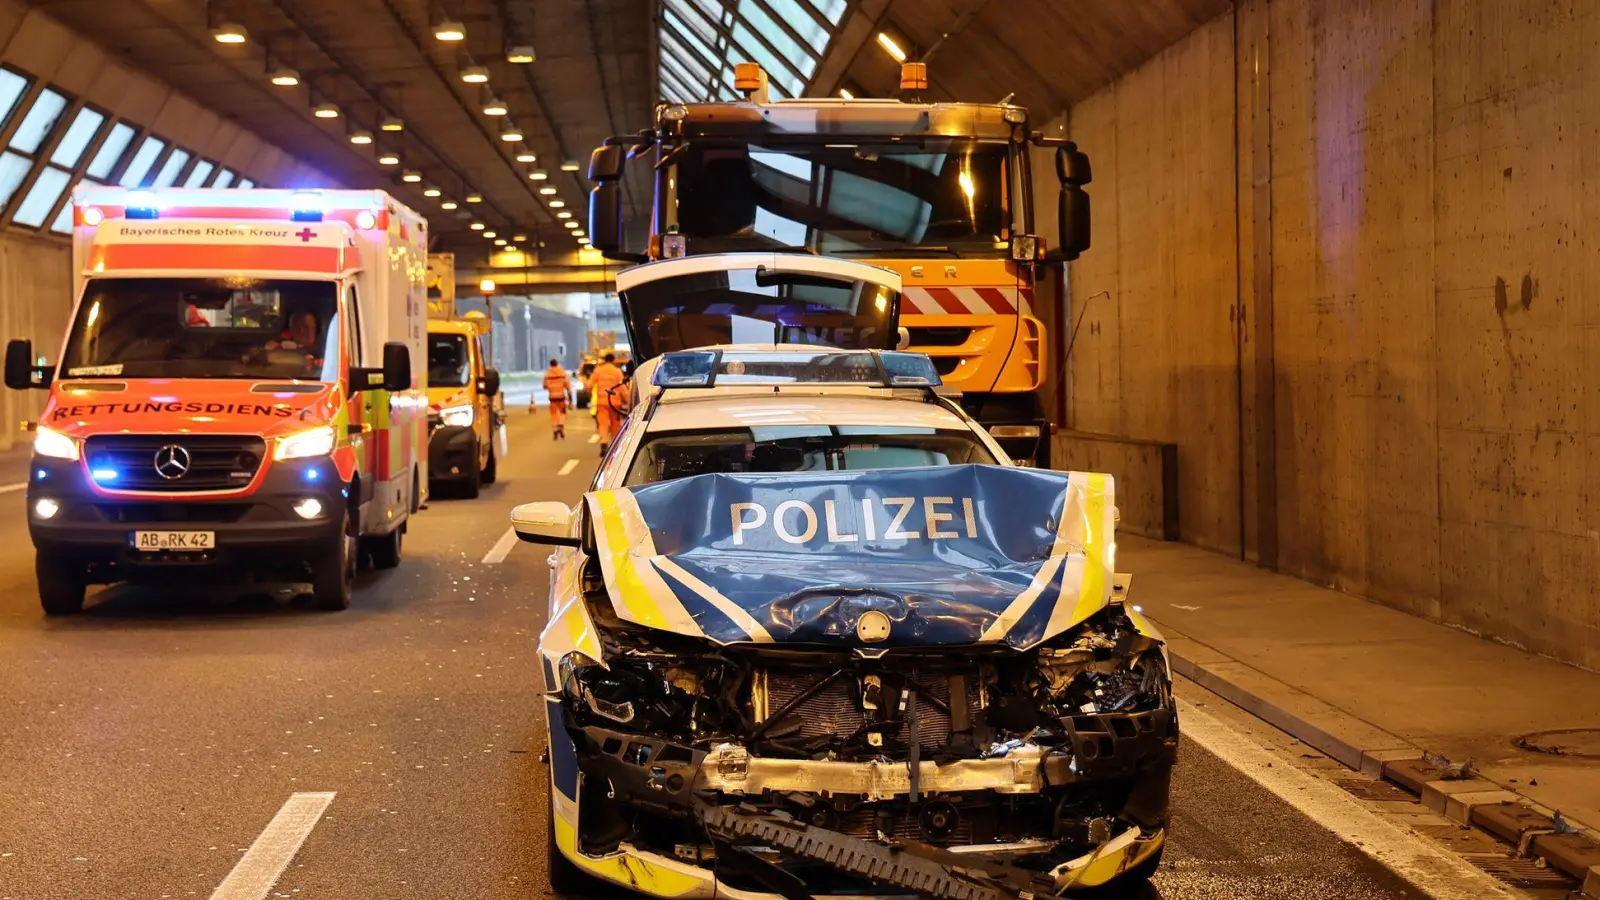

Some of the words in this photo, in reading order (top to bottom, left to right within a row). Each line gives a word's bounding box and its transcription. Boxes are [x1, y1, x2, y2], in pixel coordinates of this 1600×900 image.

[120, 227, 201, 236] Bayerisches
[206, 227, 245, 237] Rotes
[250, 228, 289, 238] Kreuz
[53, 402, 312, 421] RETTUNGSDIENST
[730, 496, 978, 545] POLIZEI
[141, 533, 159, 546] AB
[168, 533, 187, 546] RK
[190, 533, 208, 546] 42
